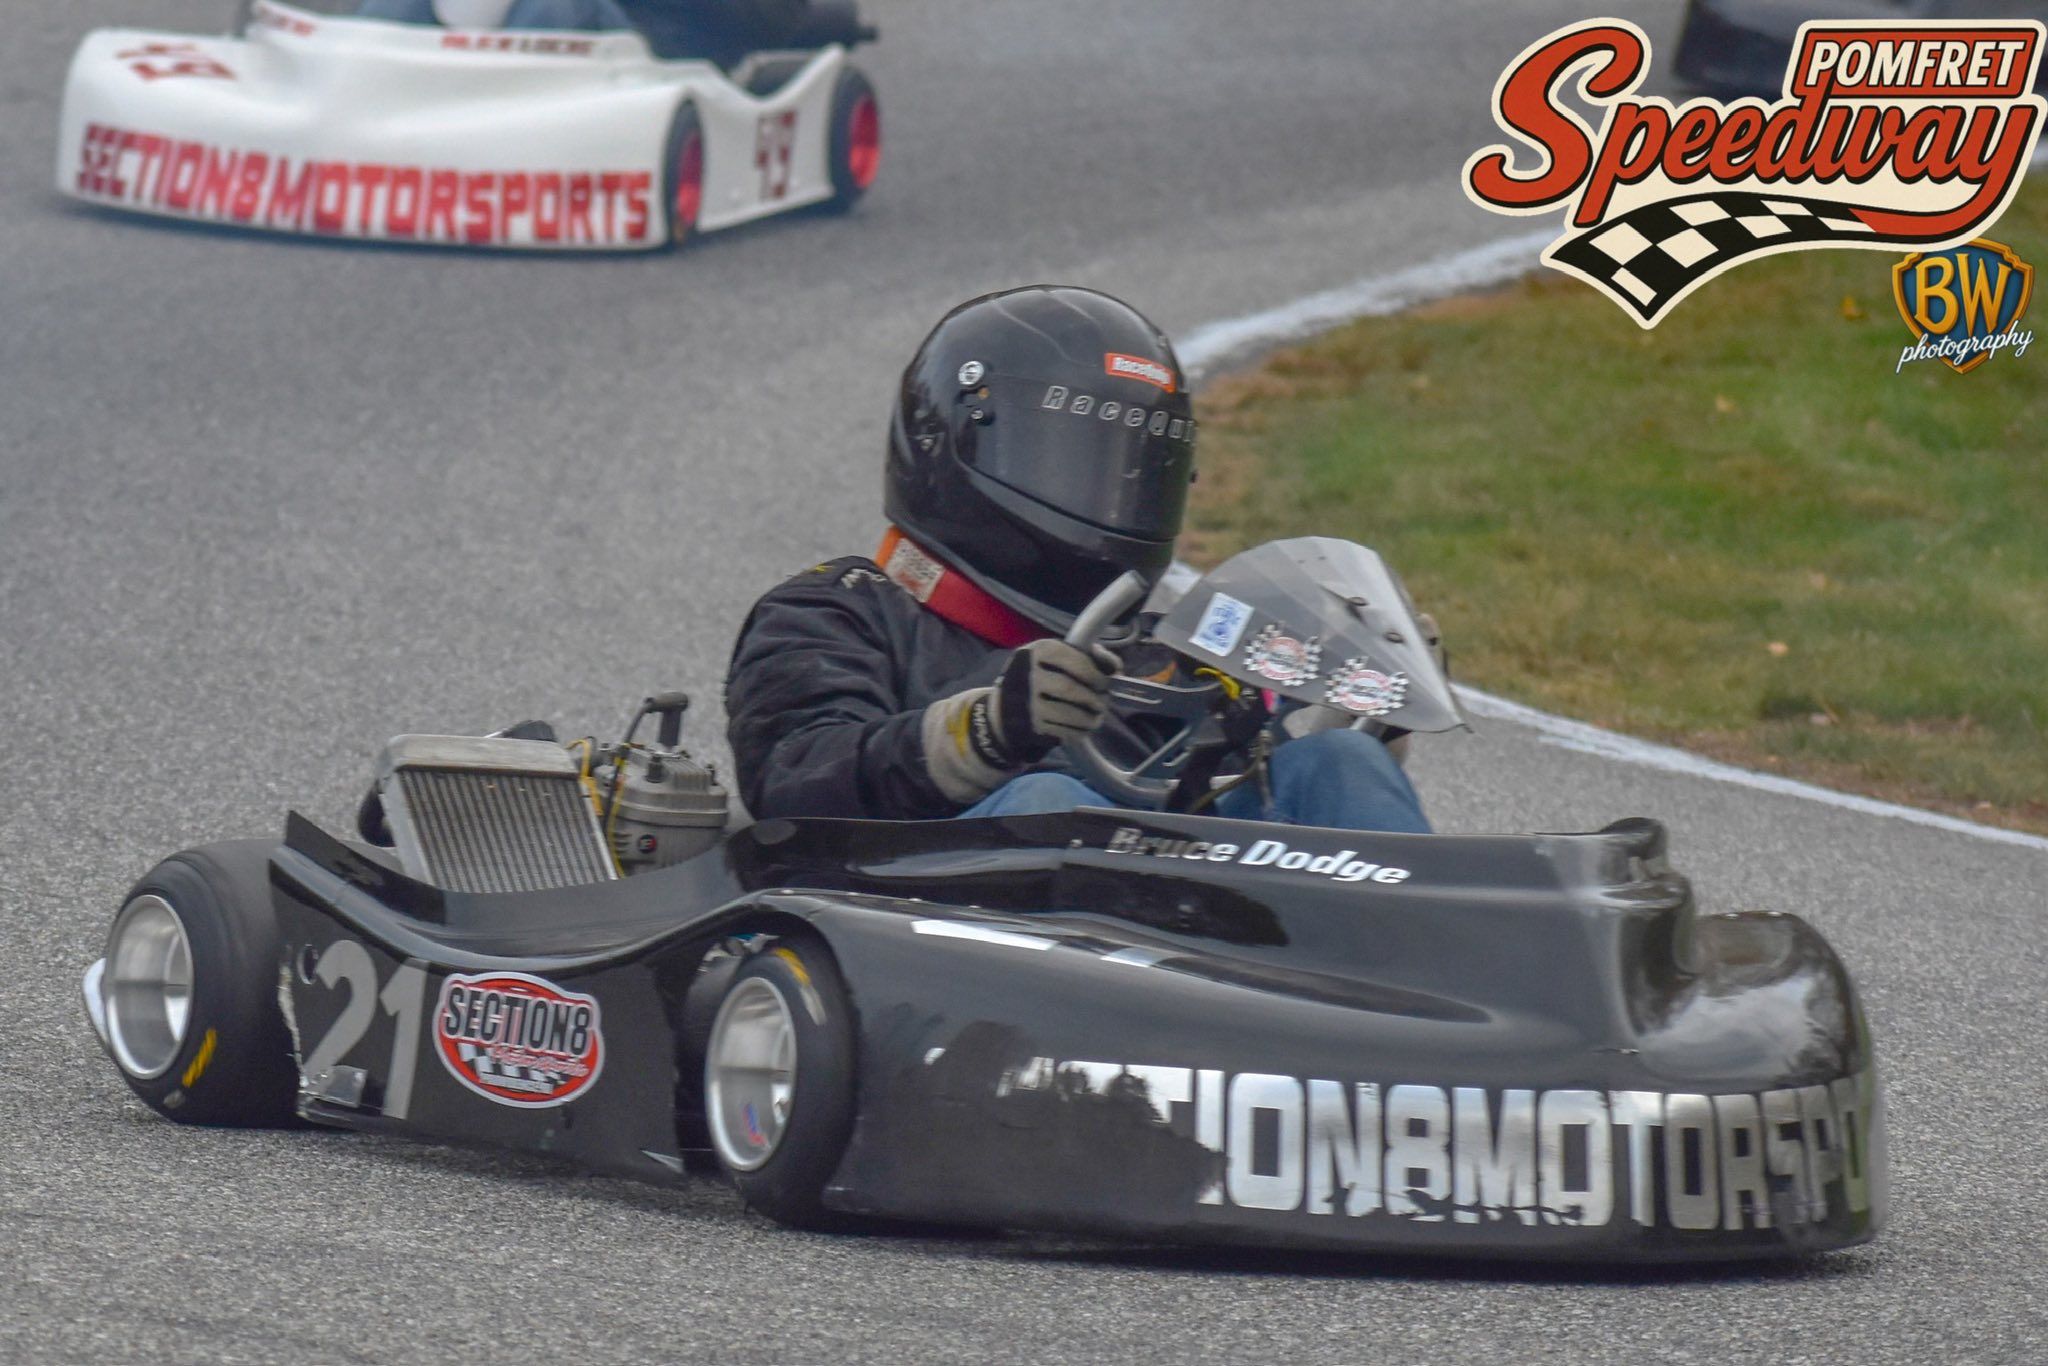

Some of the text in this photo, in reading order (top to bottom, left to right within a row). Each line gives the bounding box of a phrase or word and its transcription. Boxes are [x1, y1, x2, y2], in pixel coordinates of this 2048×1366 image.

[1041, 384, 1198, 443] RaceQui
[1104, 827, 1411, 884] Bruce Dodge
[302, 939, 431, 1122] 21
[444, 984, 591, 1056] SECTION8
